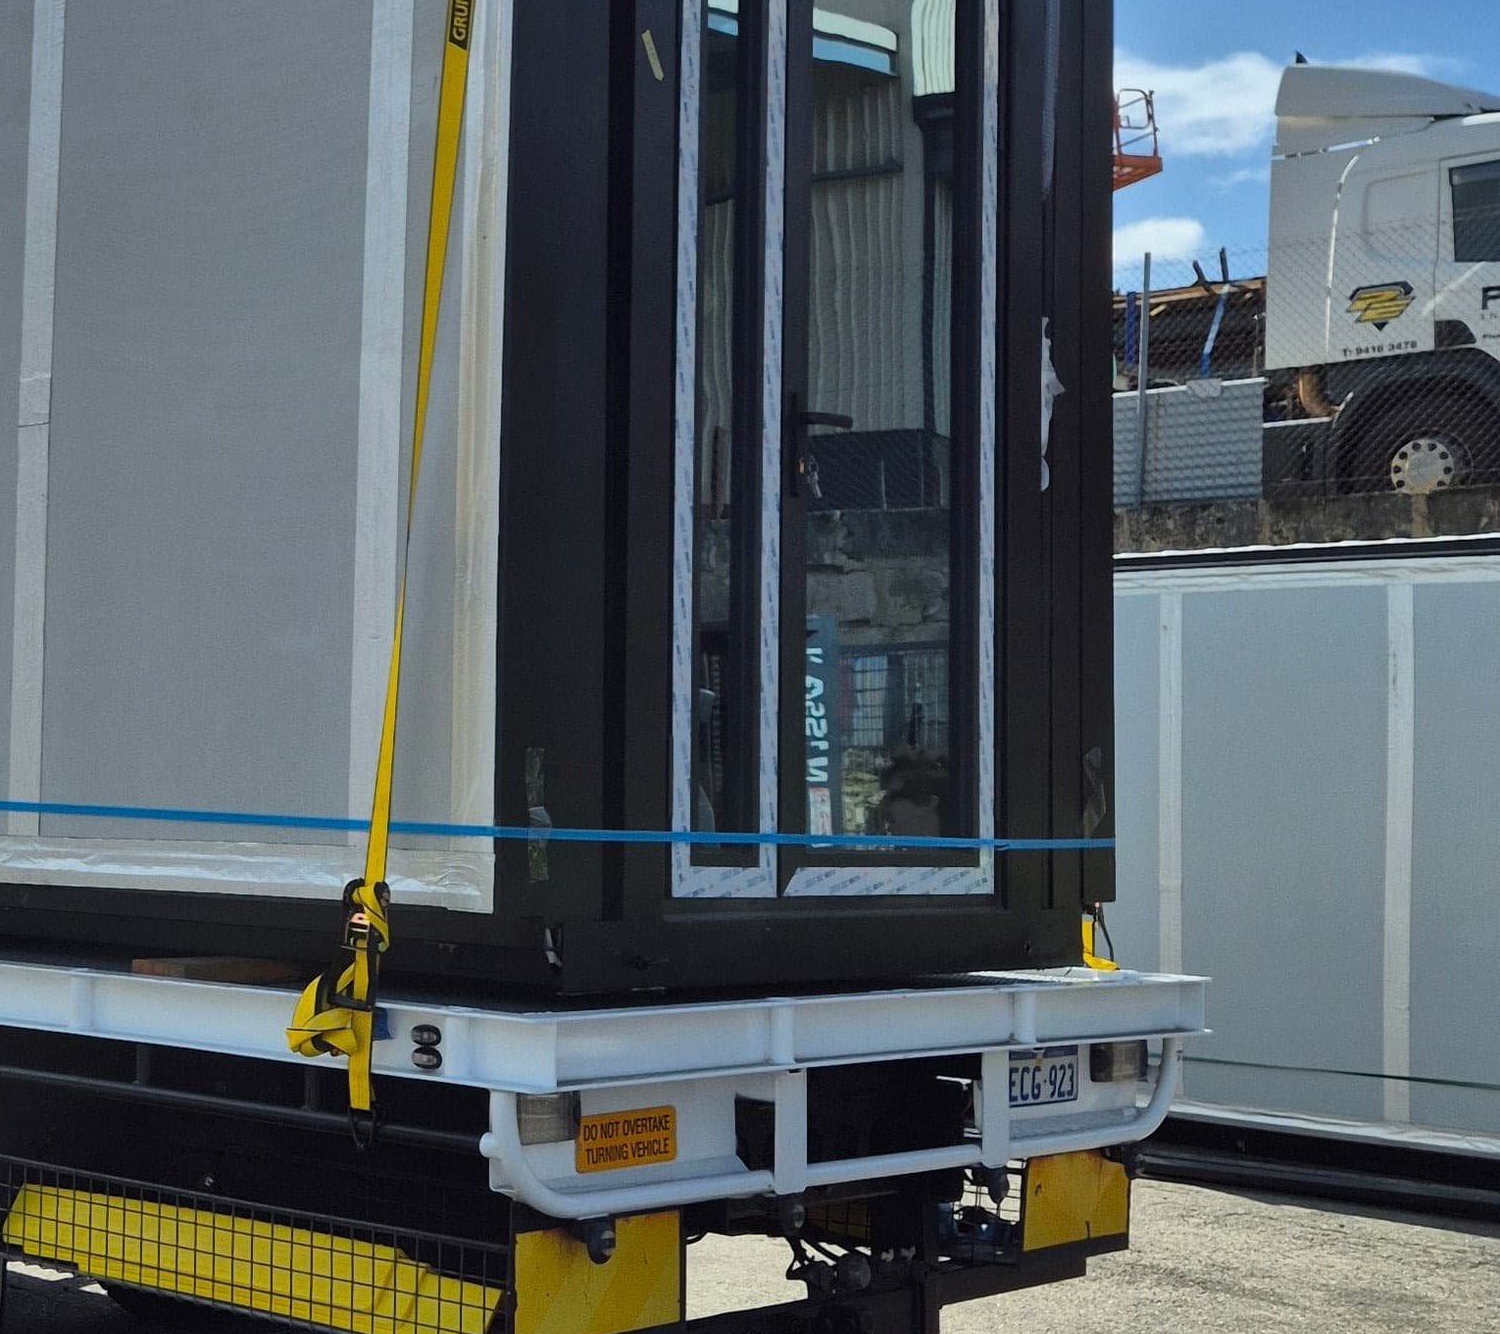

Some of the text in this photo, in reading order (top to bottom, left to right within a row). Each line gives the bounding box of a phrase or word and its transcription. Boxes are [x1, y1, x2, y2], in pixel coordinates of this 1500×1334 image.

[583, 1115, 670, 1142] DO NOT OVERTAKE
[585, 1137, 669, 1165] TURNING VEHICLE
